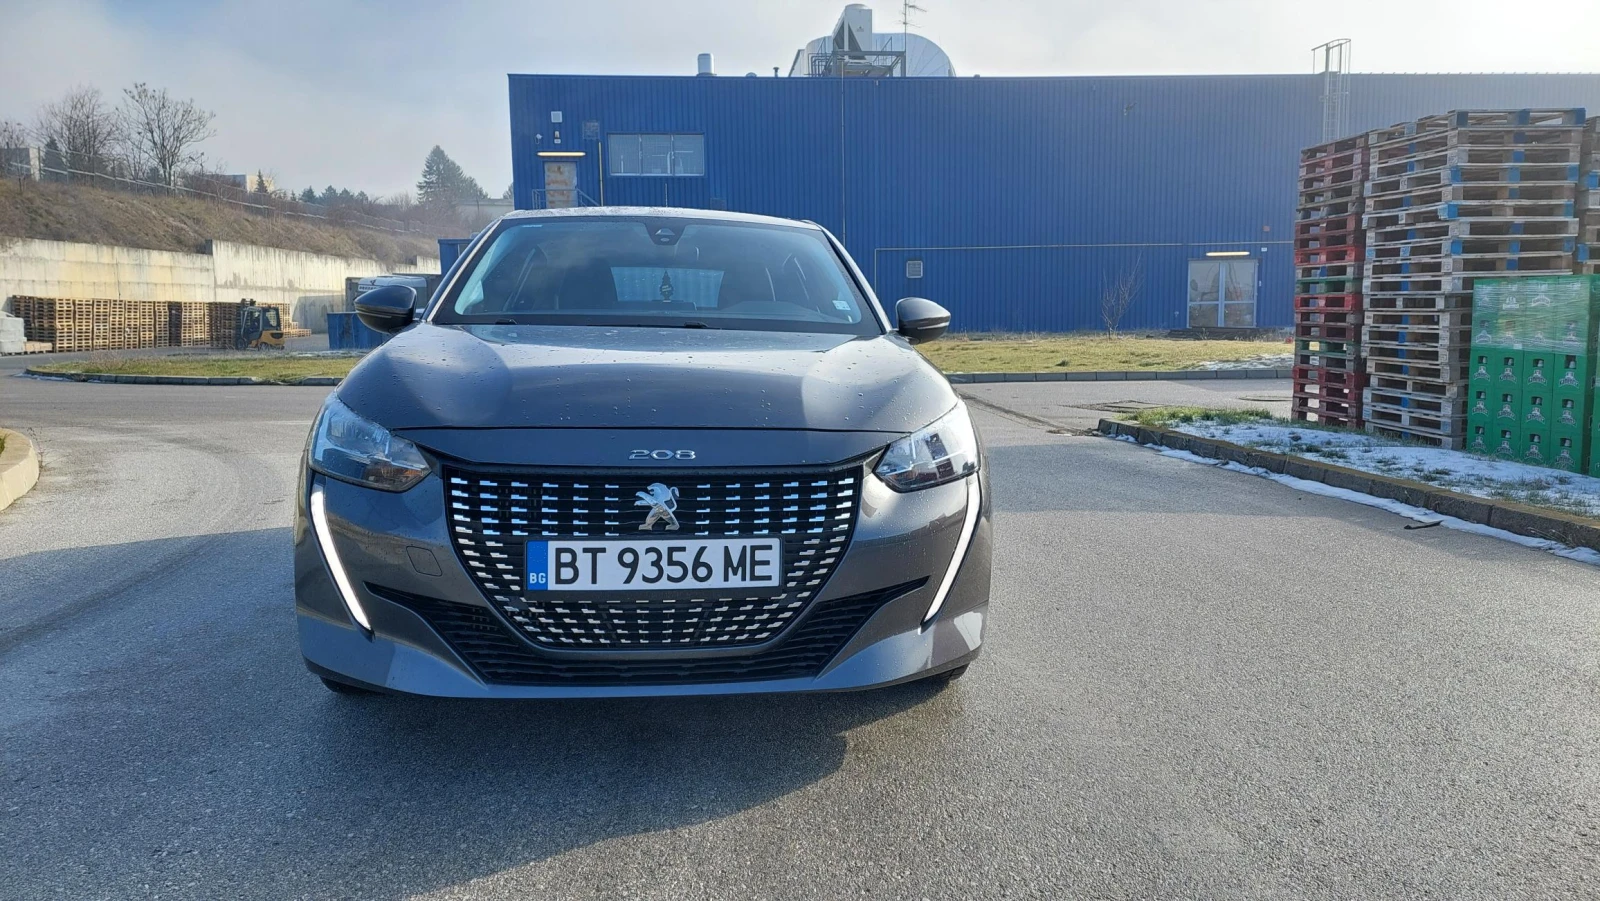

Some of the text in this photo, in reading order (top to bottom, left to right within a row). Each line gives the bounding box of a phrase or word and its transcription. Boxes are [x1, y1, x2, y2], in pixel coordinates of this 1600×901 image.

[629, 449, 696, 460] 208
[555, 544, 773, 585] BT 9356 ME
[529, 572, 547, 584] BG
